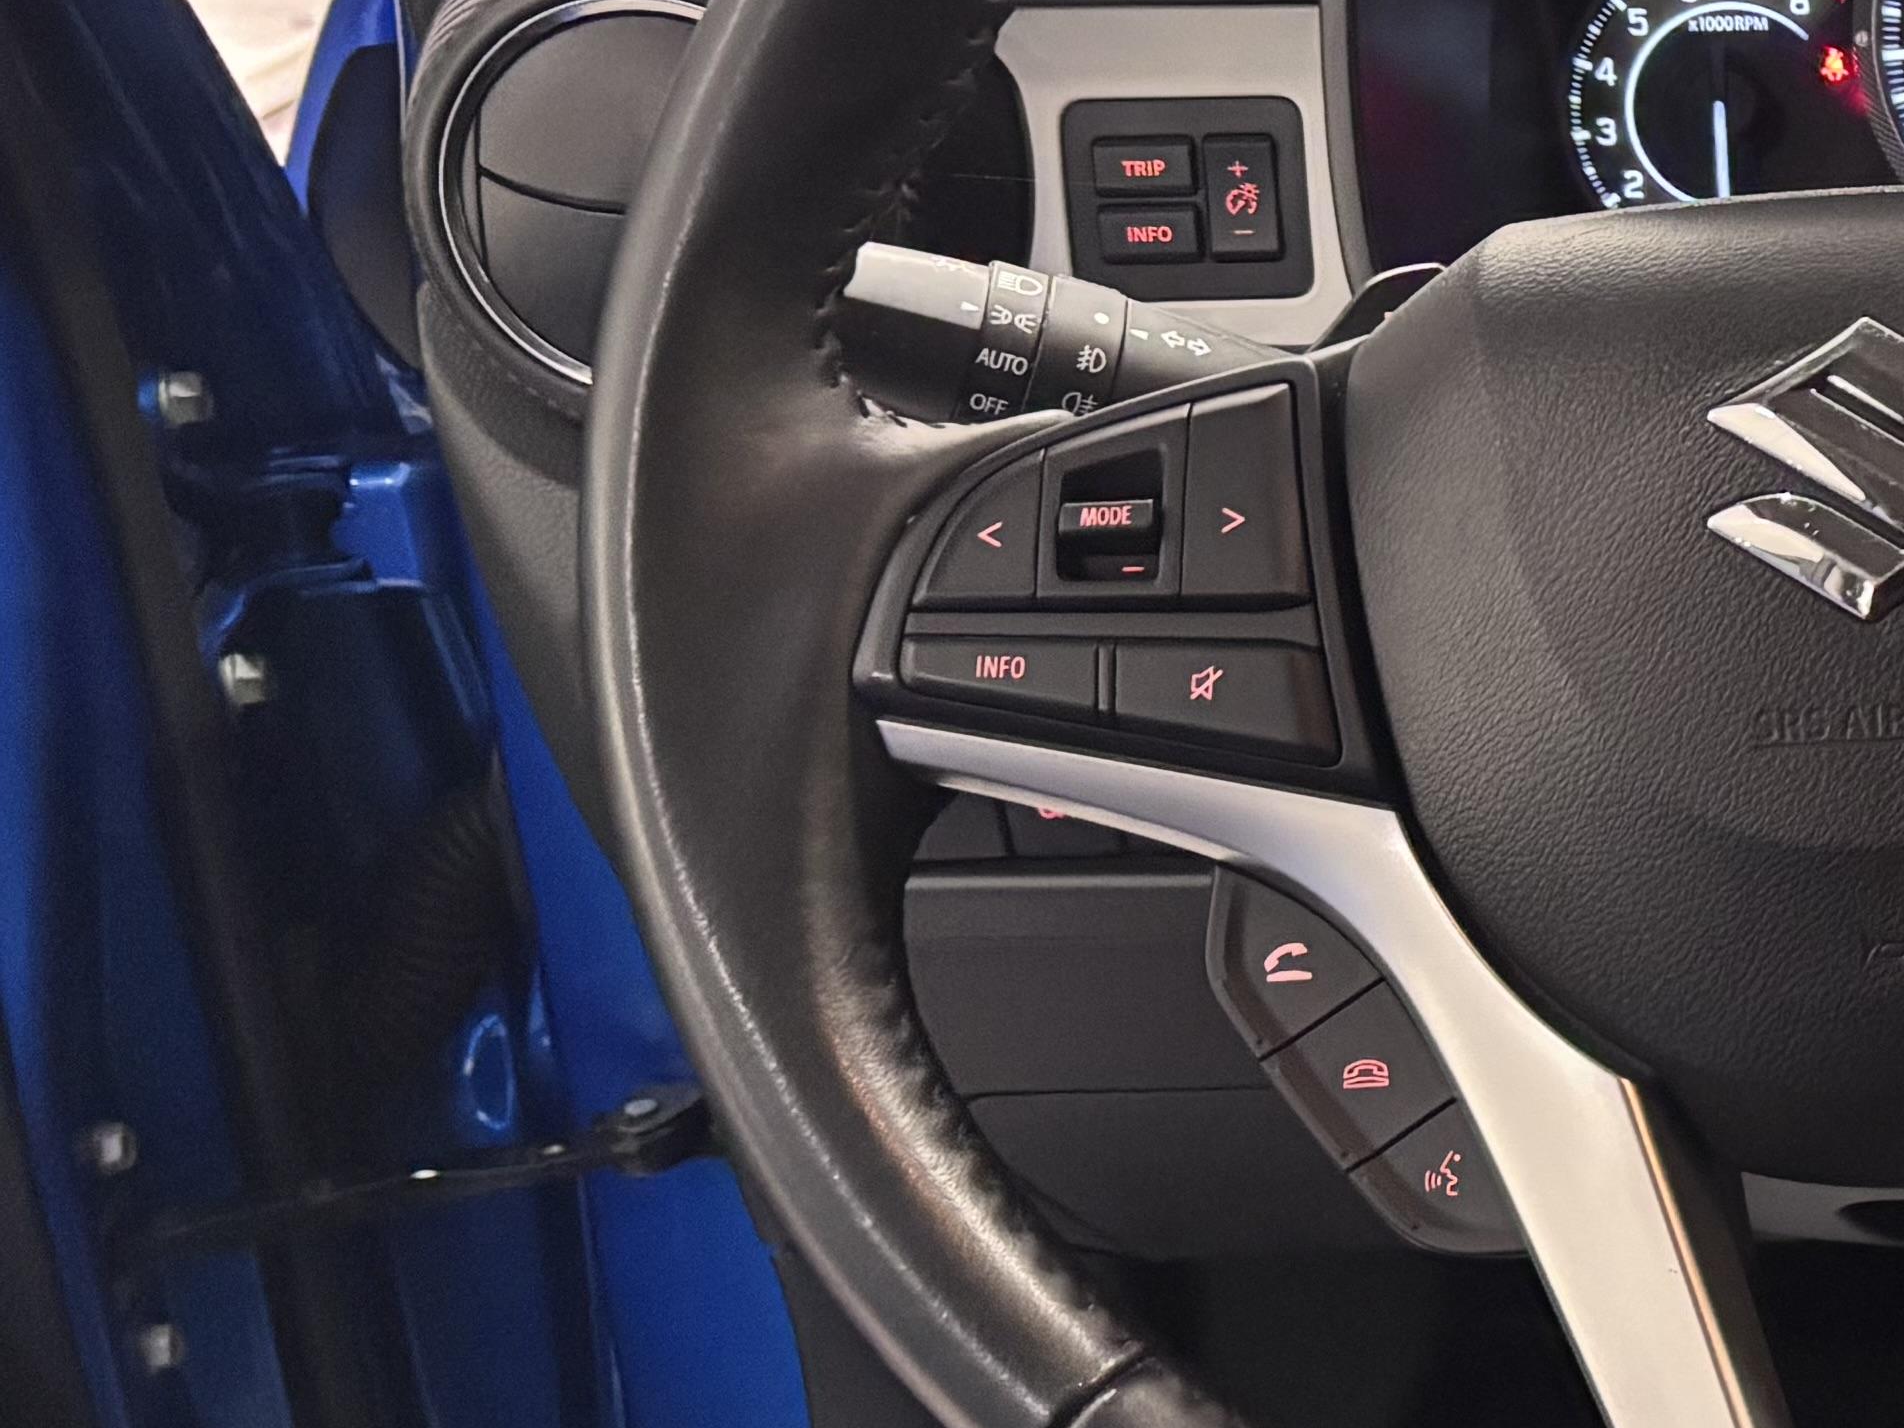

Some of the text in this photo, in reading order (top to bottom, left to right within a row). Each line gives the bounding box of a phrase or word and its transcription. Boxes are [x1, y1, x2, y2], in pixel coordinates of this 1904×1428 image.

[1626, 7, 1650, 37] 5
[1594, 56, 1618, 87] 4
[1595, 116, 1618, 147] 3
[1121, 159, 1166, 177] TRIP
[1622, 169, 1645, 199] 2
[1126, 225, 1173, 243] INFO
[975, 347, 1029, 376] AUTO
[969, 393, 1009, 416] OFF
[1079, 505, 1132, 527] MODE
[975, 655, 1026, 679] INFO
